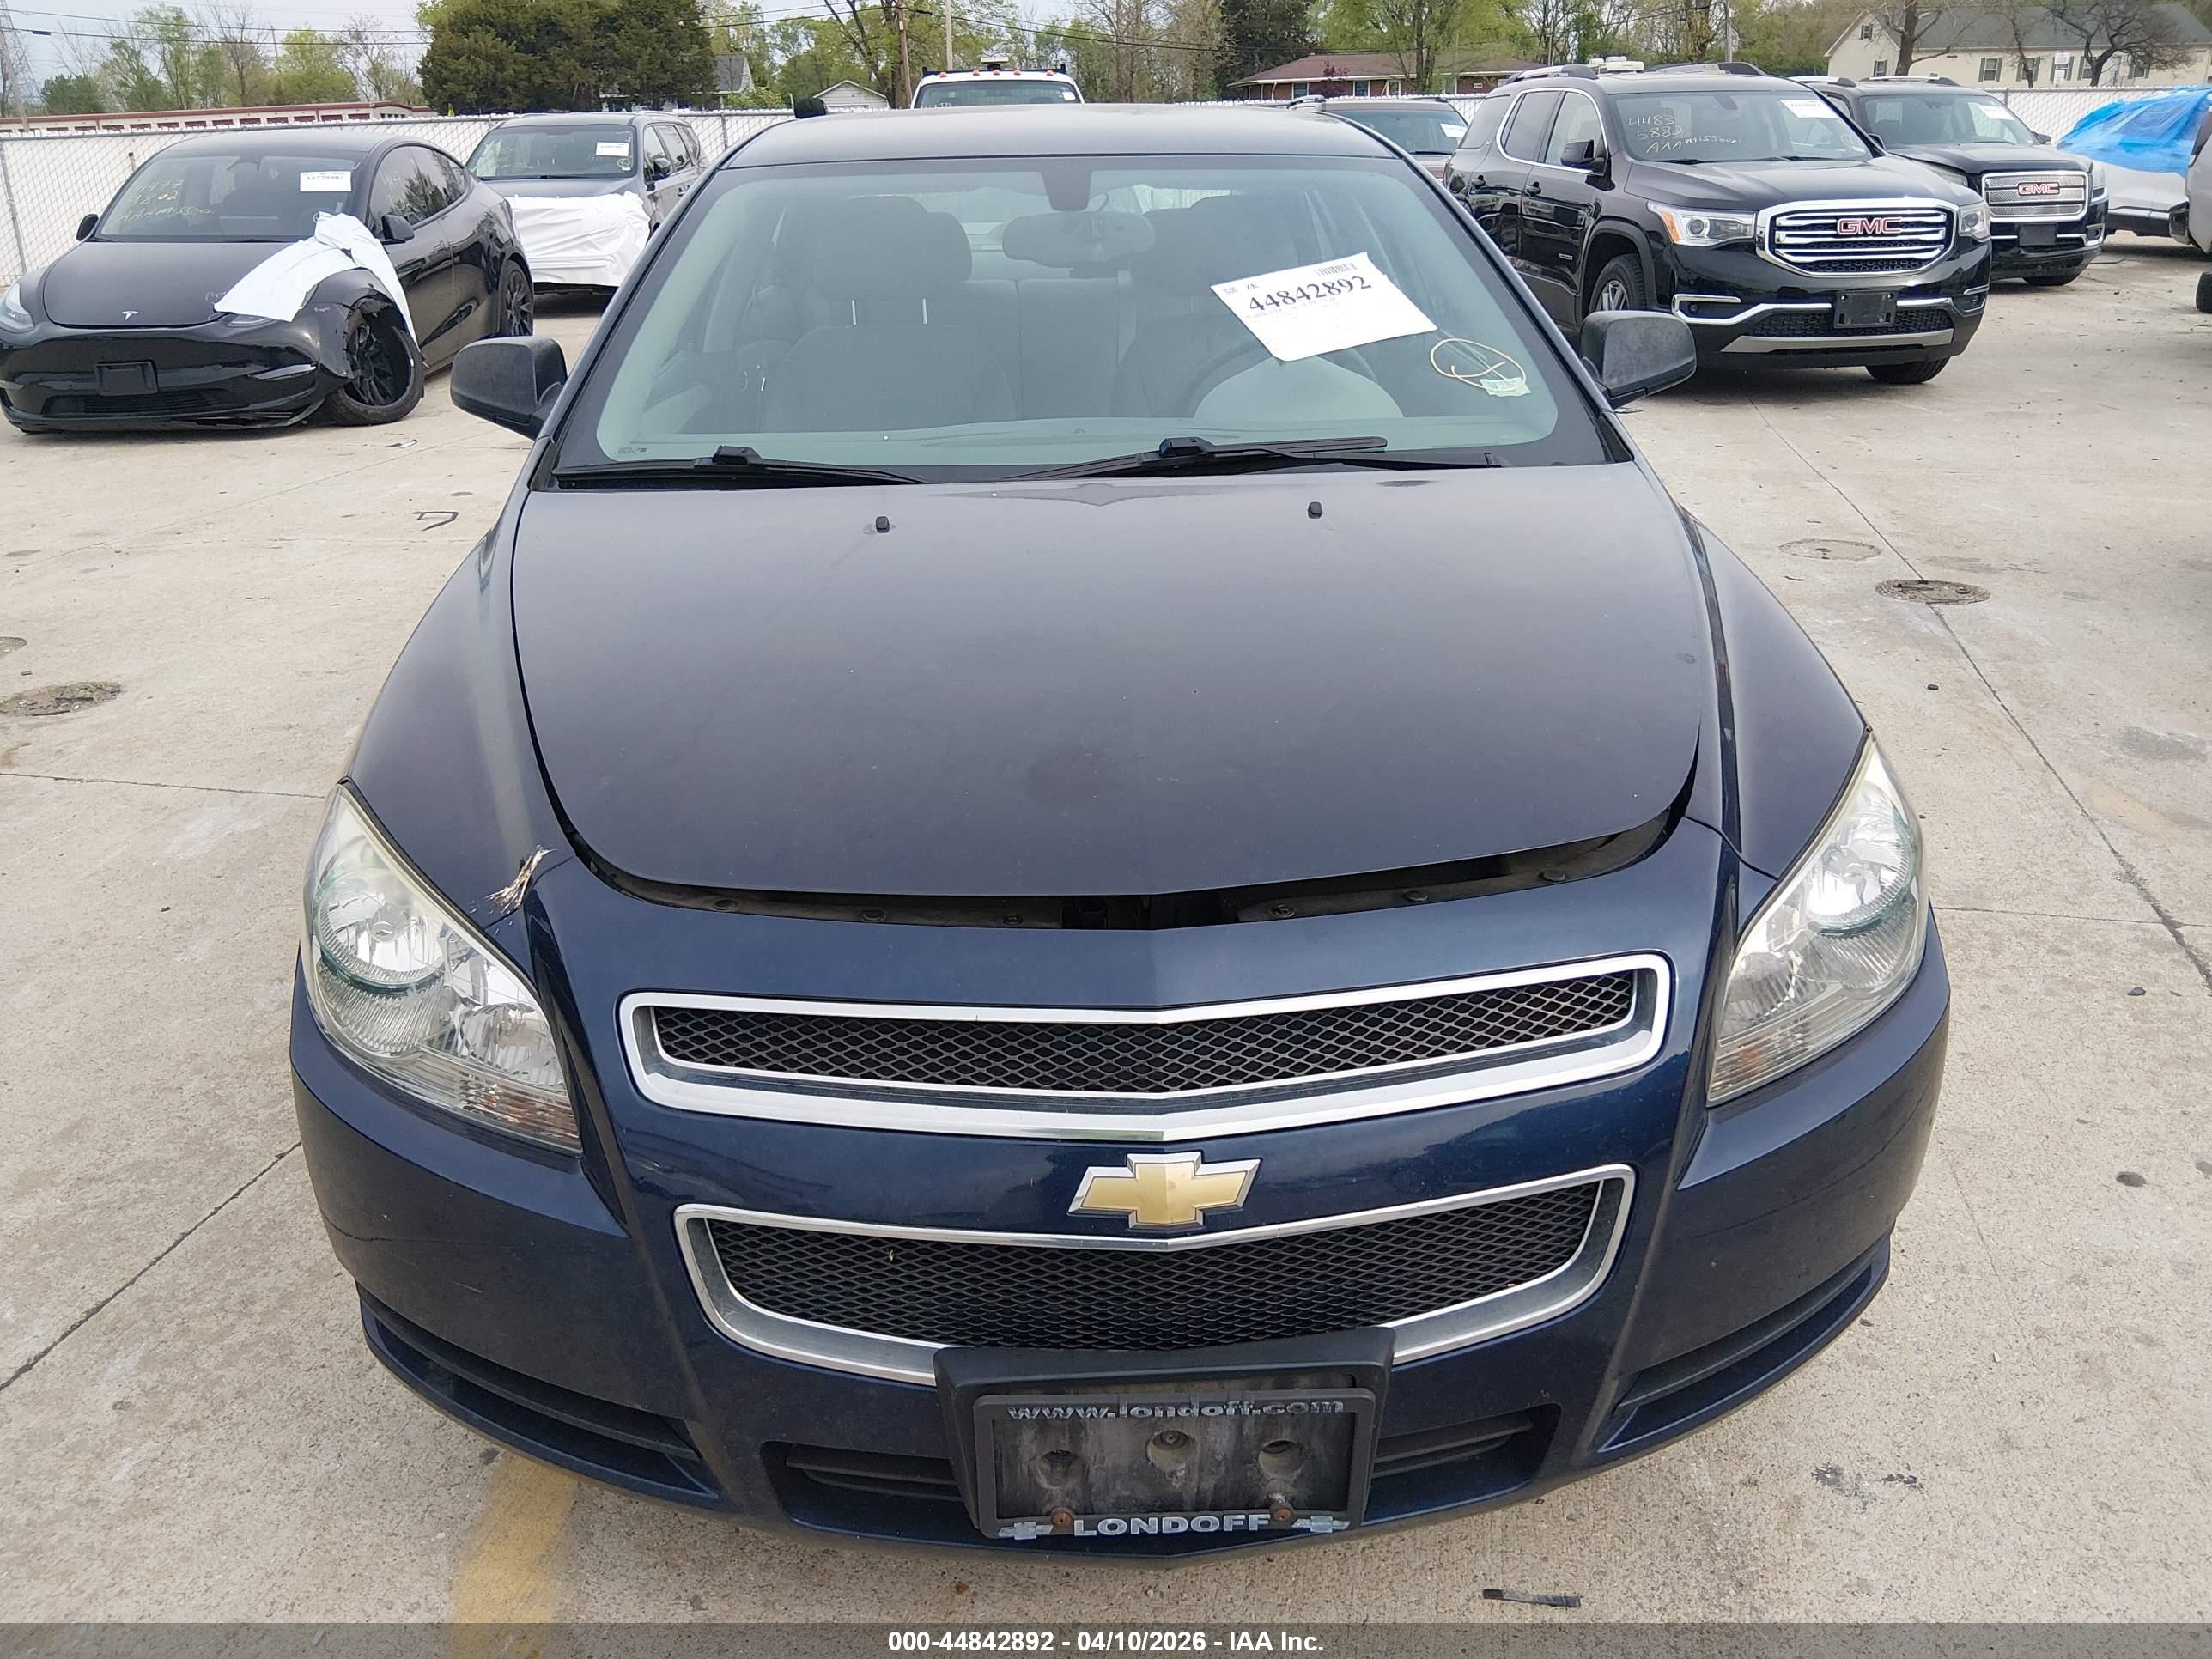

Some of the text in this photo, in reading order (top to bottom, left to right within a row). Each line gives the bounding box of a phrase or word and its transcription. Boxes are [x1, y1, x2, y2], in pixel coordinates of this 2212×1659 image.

[2018, 183, 2058, 194] GMC
[1838, 217, 1902, 234] GMC
[1249, 276, 1371, 311] 44842892
[1008, 1400, 1345, 1419] www.londoff.com
[1073, 1513, 1271, 1536] LONDOFF
